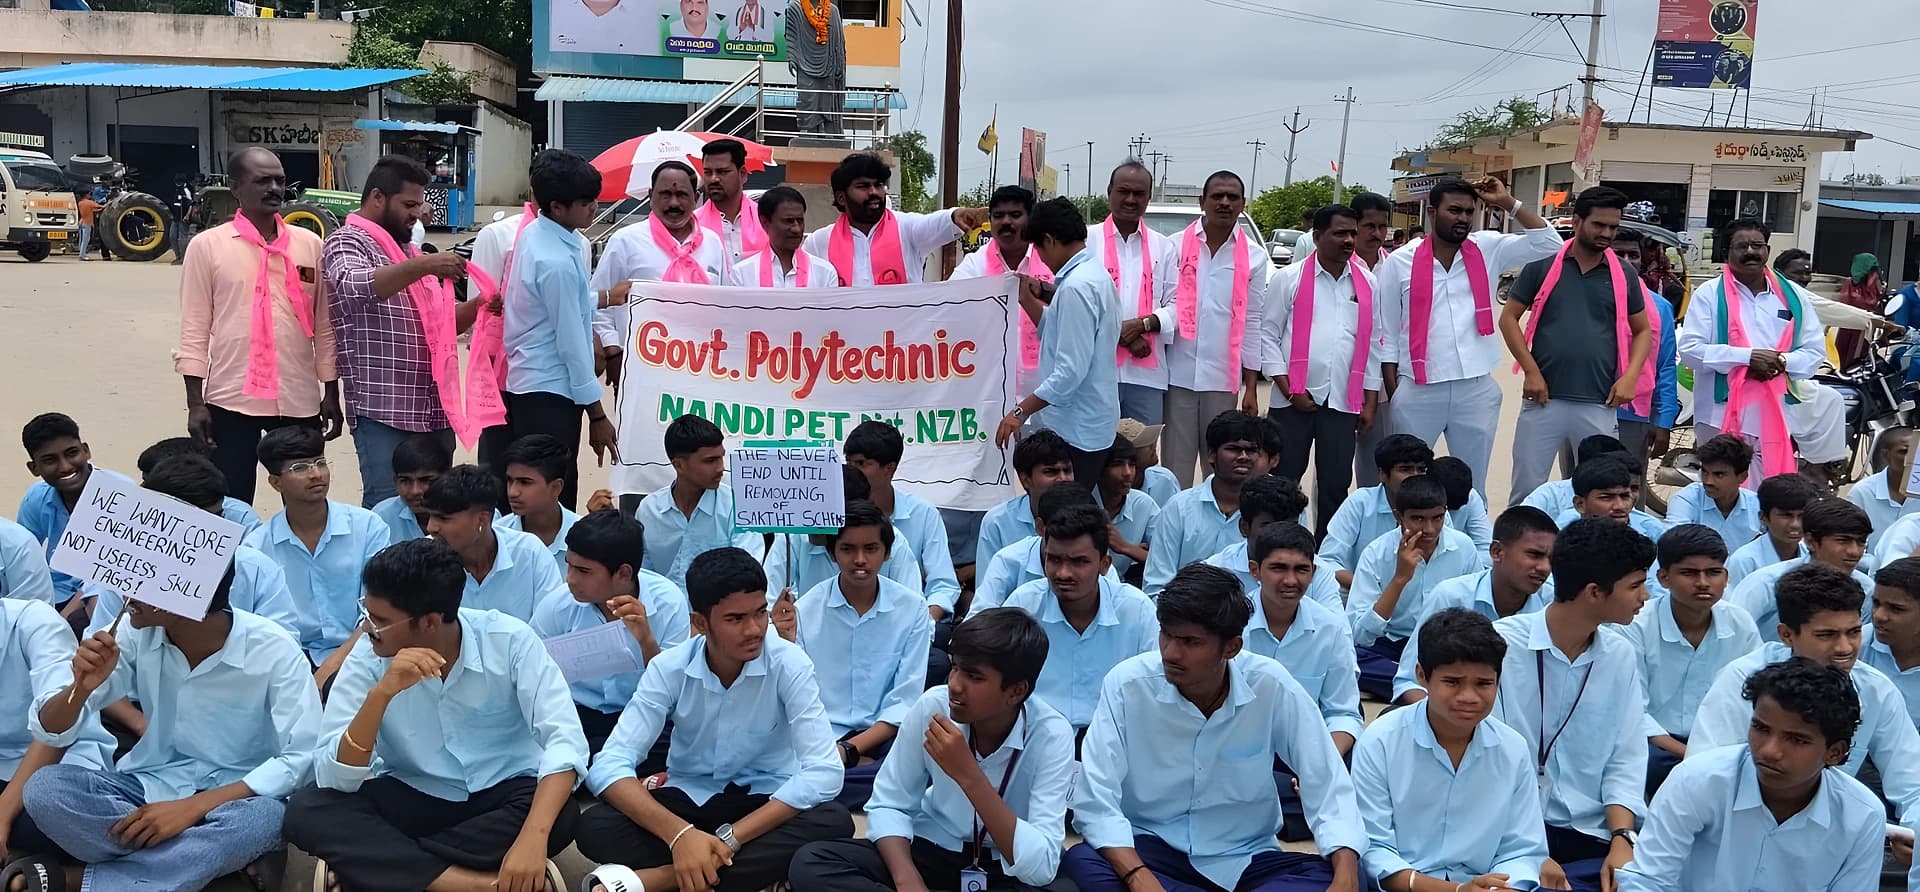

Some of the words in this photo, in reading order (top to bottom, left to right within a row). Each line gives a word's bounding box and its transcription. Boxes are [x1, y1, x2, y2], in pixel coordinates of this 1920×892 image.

[248, 126, 279, 143] SK
[637, 320, 742, 380] Govt.
[745, 328, 978, 400] Polytechnic
[659, 392, 775, 437] NANDI
[784, 407, 851, 442] PET
[915, 407, 986, 443] NZB.
[734, 449, 769, 461] THE
[777, 448, 839, 463] NEVER
[741, 466, 772, 480] END
[780, 465, 827, 481] UNTIL
[744, 484, 825, 503] REMOVING
[91, 487, 127, 514] WE
[129, 501, 184, 537] WANT
[183, 525, 232, 557] CORE
[735, 510, 796, 527] SAKTHI
[94, 515, 196, 566] ENEINEERING
[62, 531, 95, 554] NOT
[98, 545, 158, 579] USELESS
[159, 573, 203, 599] SKILL
[92, 562, 143, 595] TAGS!
